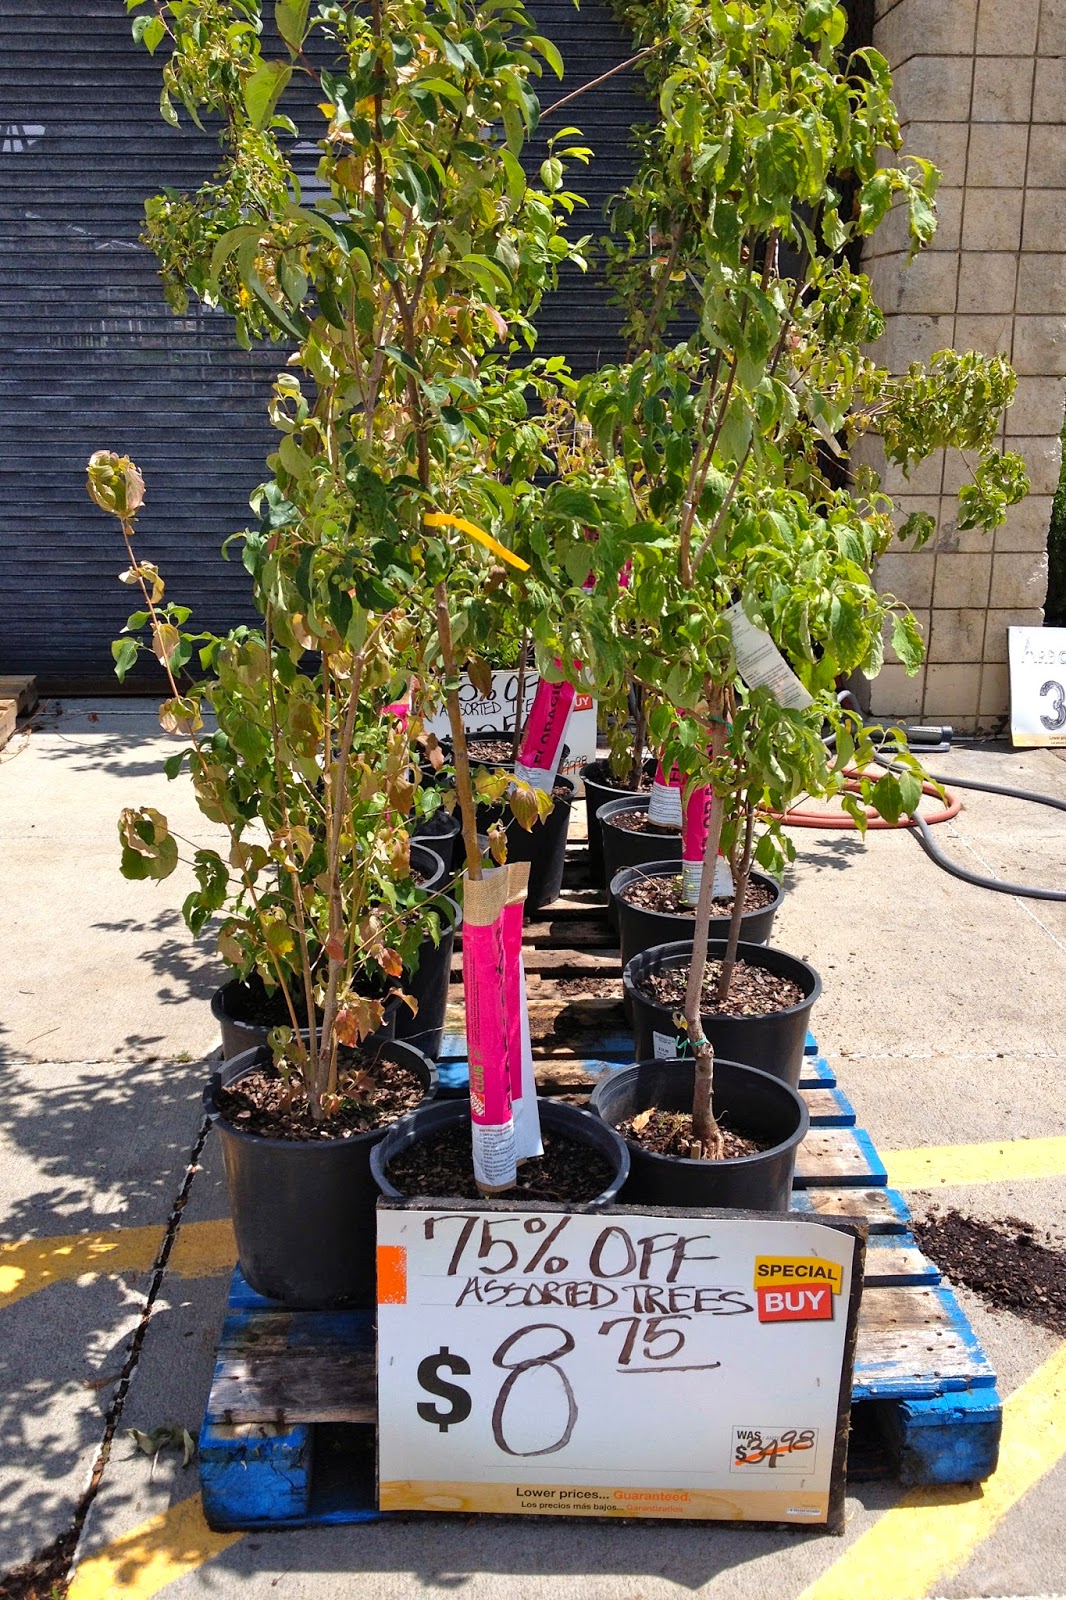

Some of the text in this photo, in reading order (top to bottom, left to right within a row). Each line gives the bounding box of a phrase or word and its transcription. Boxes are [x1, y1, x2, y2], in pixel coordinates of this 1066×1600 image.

[575, 696, 590, 707] UY
[424, 1216, 720, 1282] 75% OFF
[757, 1264, 838, 1281] SPECIAL
[455, 1277, 754, 1315] ASSORTED TREES
[765, 1290, 826, 1312] BUY
[737, 1430, 761, 1440] WAS
[516, 1487, 692, 1501] Lower prices... Guaranteed.
[539, 1502, 571, 1510] precios
[593, 1503, 624, 1511] bajos...
